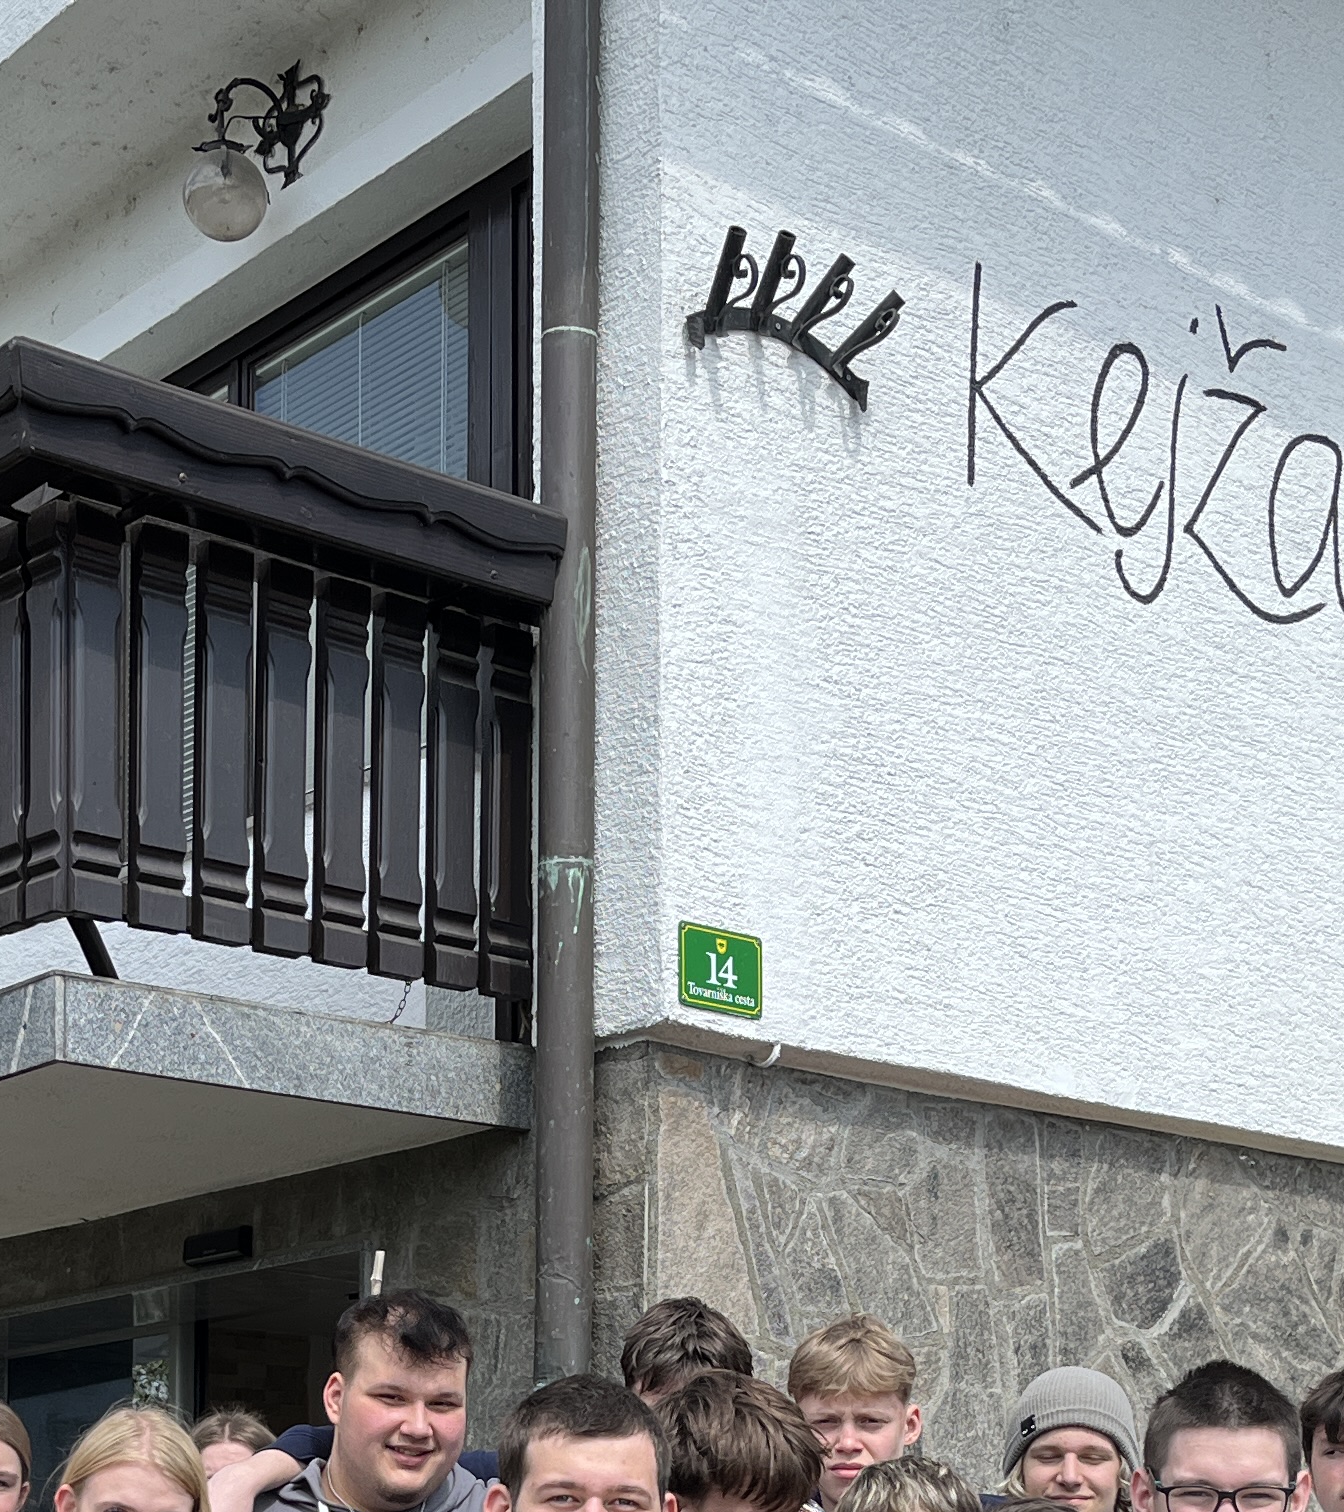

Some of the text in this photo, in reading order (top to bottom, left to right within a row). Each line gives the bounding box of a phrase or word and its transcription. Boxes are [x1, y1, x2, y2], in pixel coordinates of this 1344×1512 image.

[705, 951, 738, 989] 14
[687, 981, 755, 1007] Tovarniška cesta
